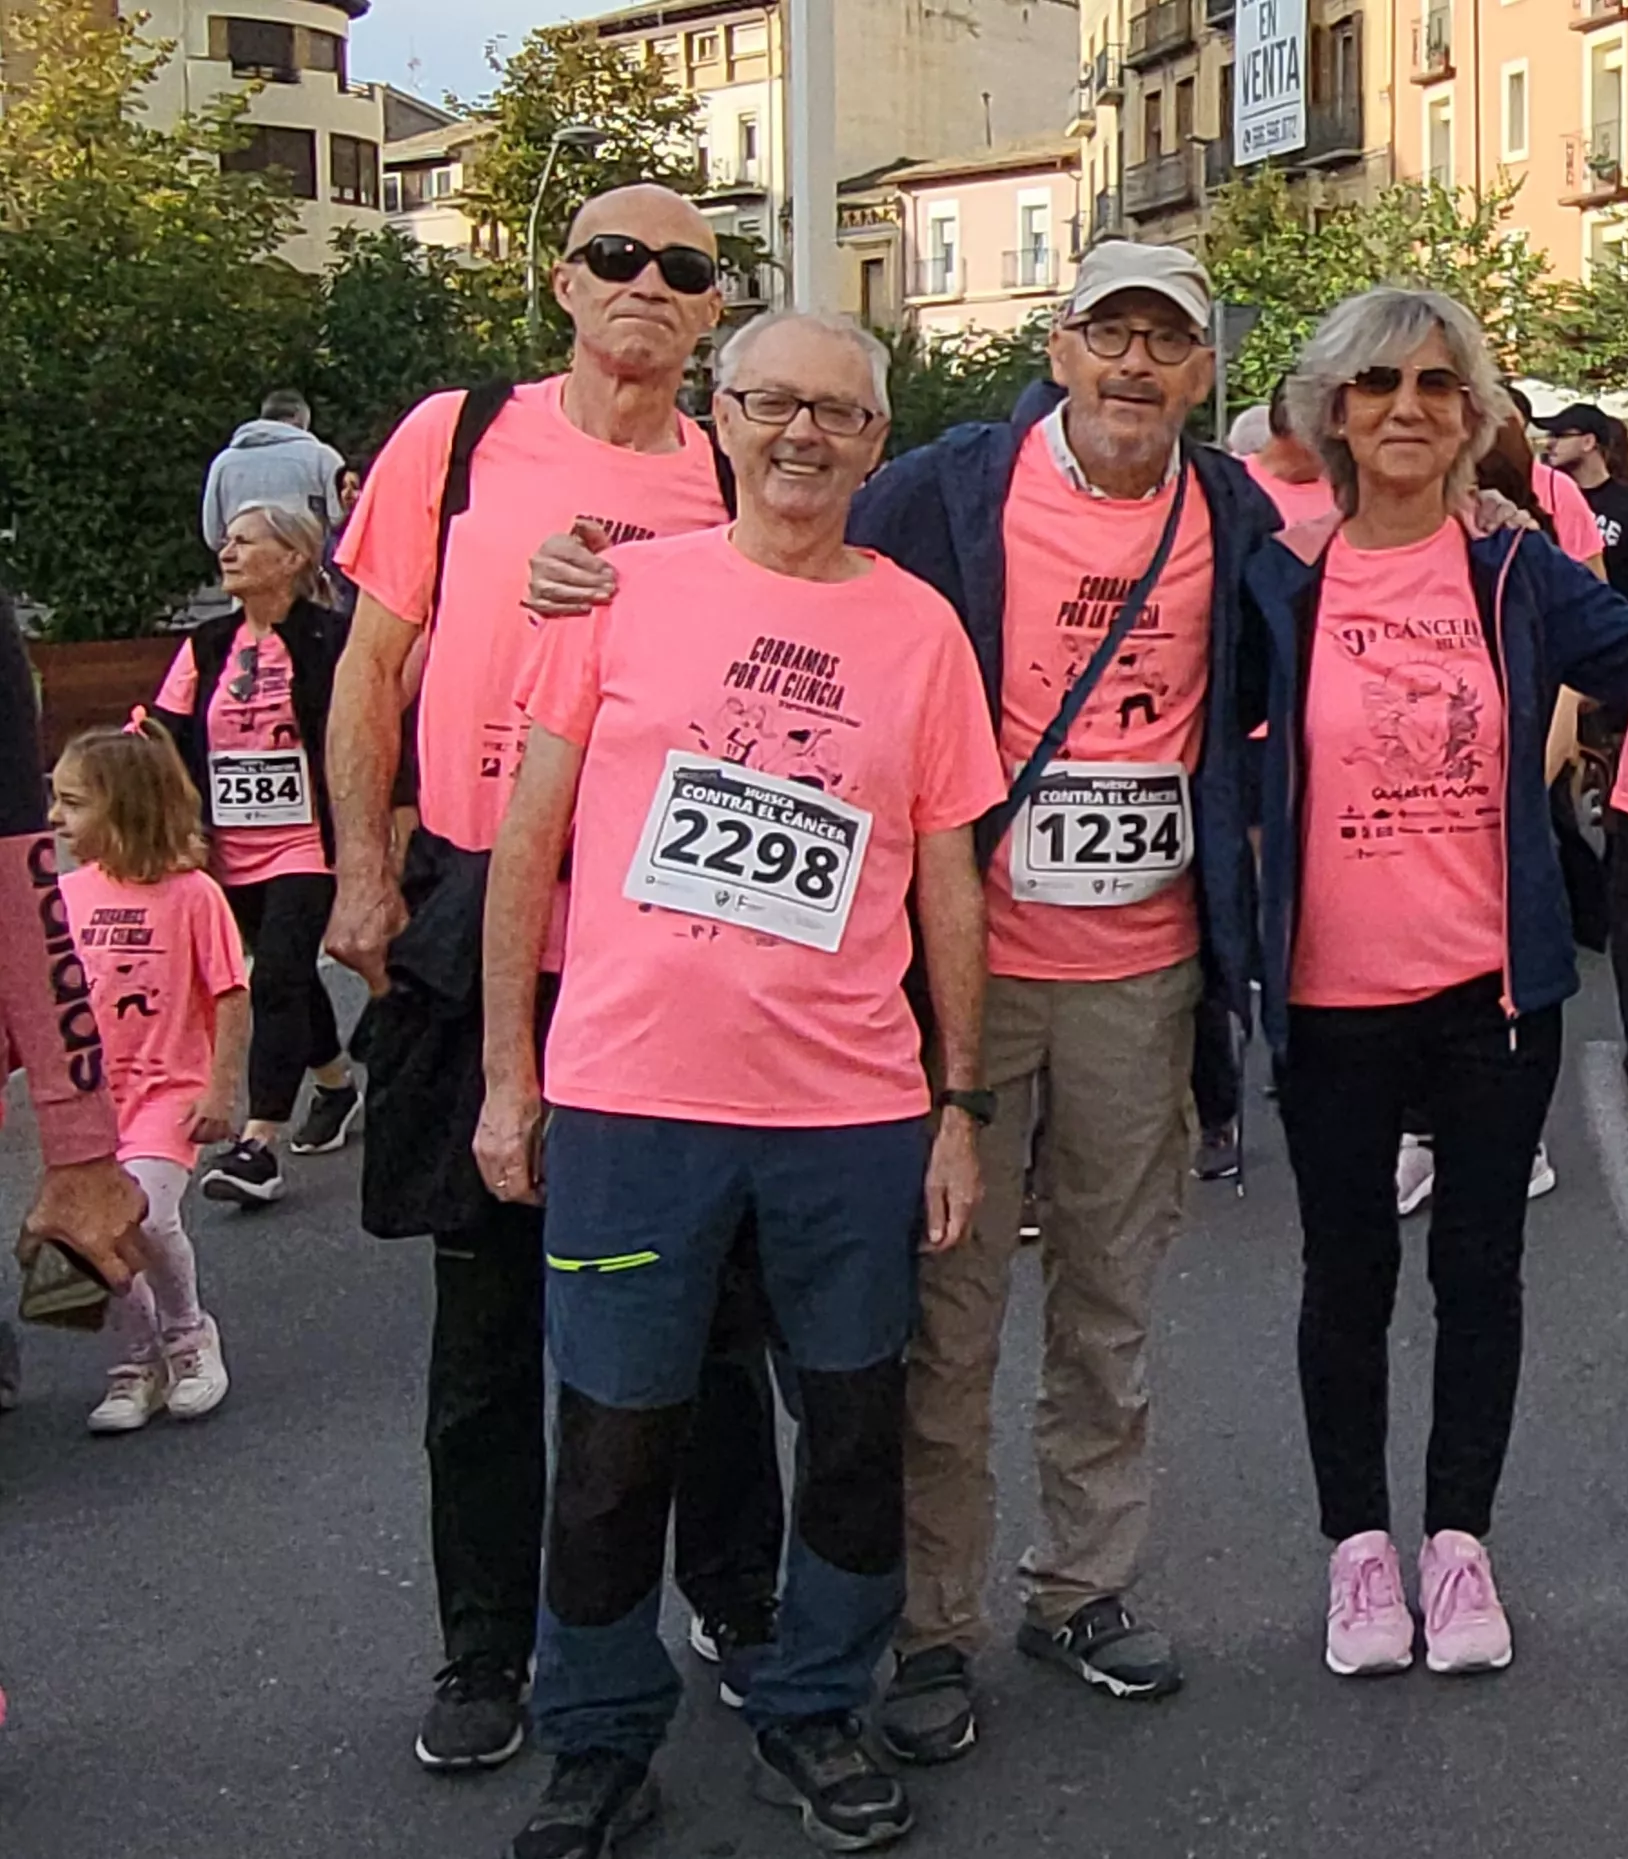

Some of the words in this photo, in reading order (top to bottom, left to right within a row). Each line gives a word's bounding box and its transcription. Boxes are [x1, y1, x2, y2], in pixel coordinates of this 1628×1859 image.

[1259, 0, 1277, 41] EN
[1242, 35, 1300, 107] VENTA
[749, 636, 840, 679] CORRAMOS
[723, 661, 761, 690] POR
[758, 667, 782, 695] LA
[781, 671, 845, 711] CIENCIA
[217, 775, 299, 805] 2584
[681, 784, 755, 816] CONTRA
[756, 804, 777, 821] EL
[779, 808, 848, 844] CÁNCER
[1039, 790, 1104, 804] CONTRA
[1107, 791, 1125, 804] EL
[659, 808, 840, 900] 2298
[1035, 812, 1181, 864] 1234
